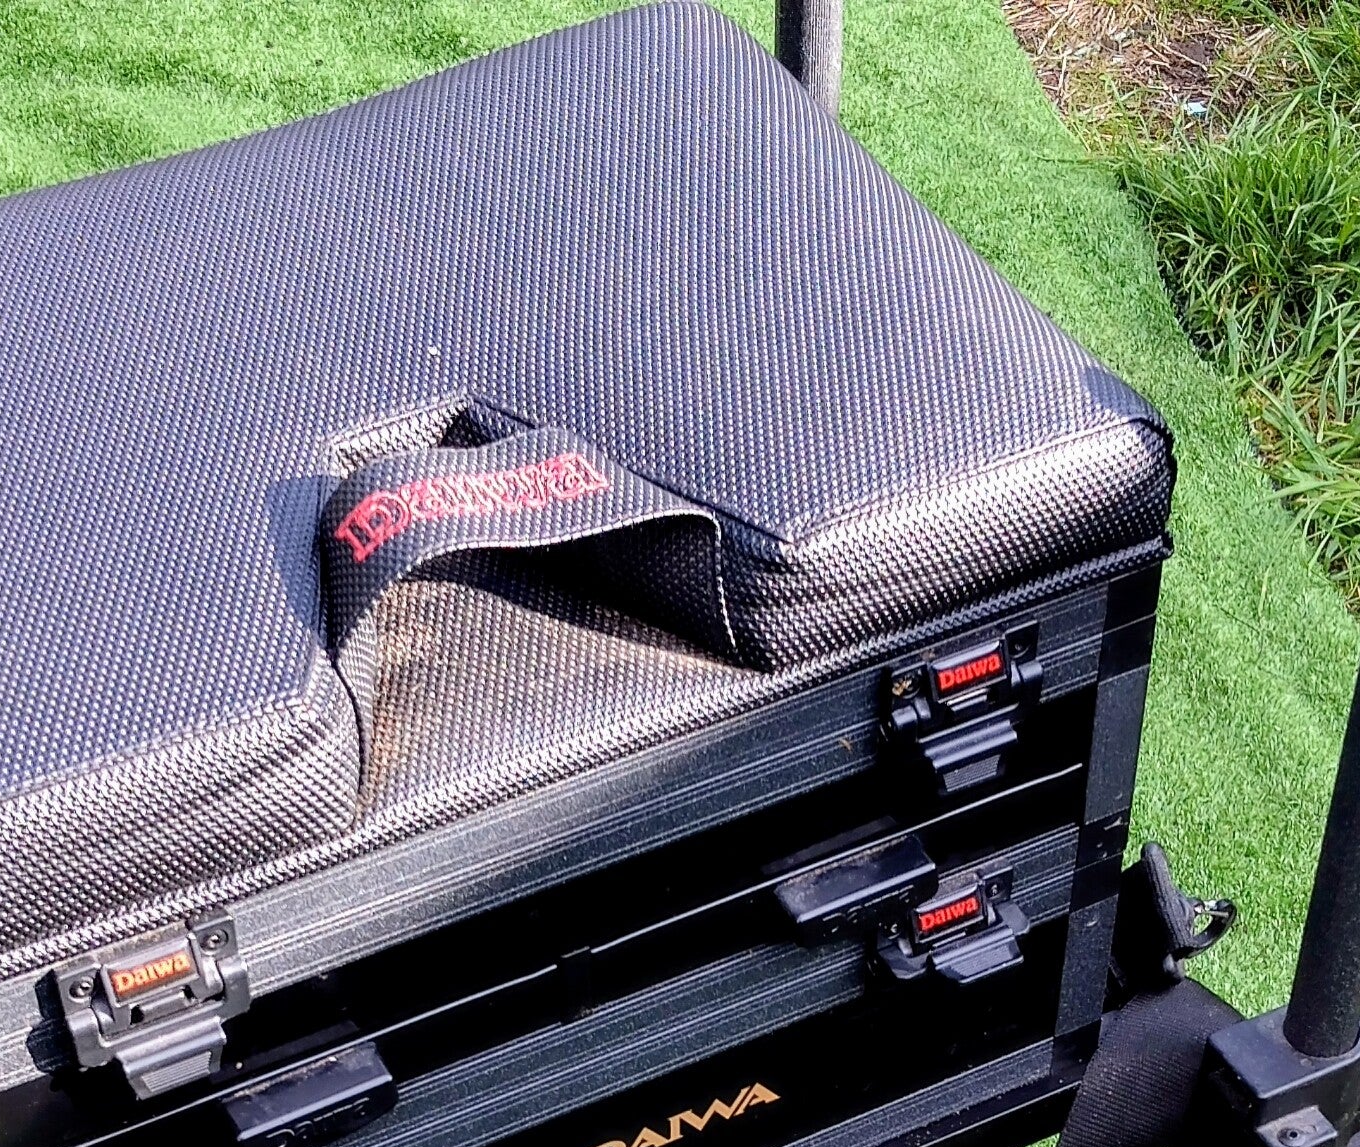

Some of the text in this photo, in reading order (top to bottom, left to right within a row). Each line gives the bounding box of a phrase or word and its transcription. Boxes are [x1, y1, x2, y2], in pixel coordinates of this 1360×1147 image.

[336, 453, 610, 562] Daiwa
[938, 652, 1003, 690] Daiwa
[918, 896, 979, 932] Daiwa
[110, 951, 192, 994] Daiwa
